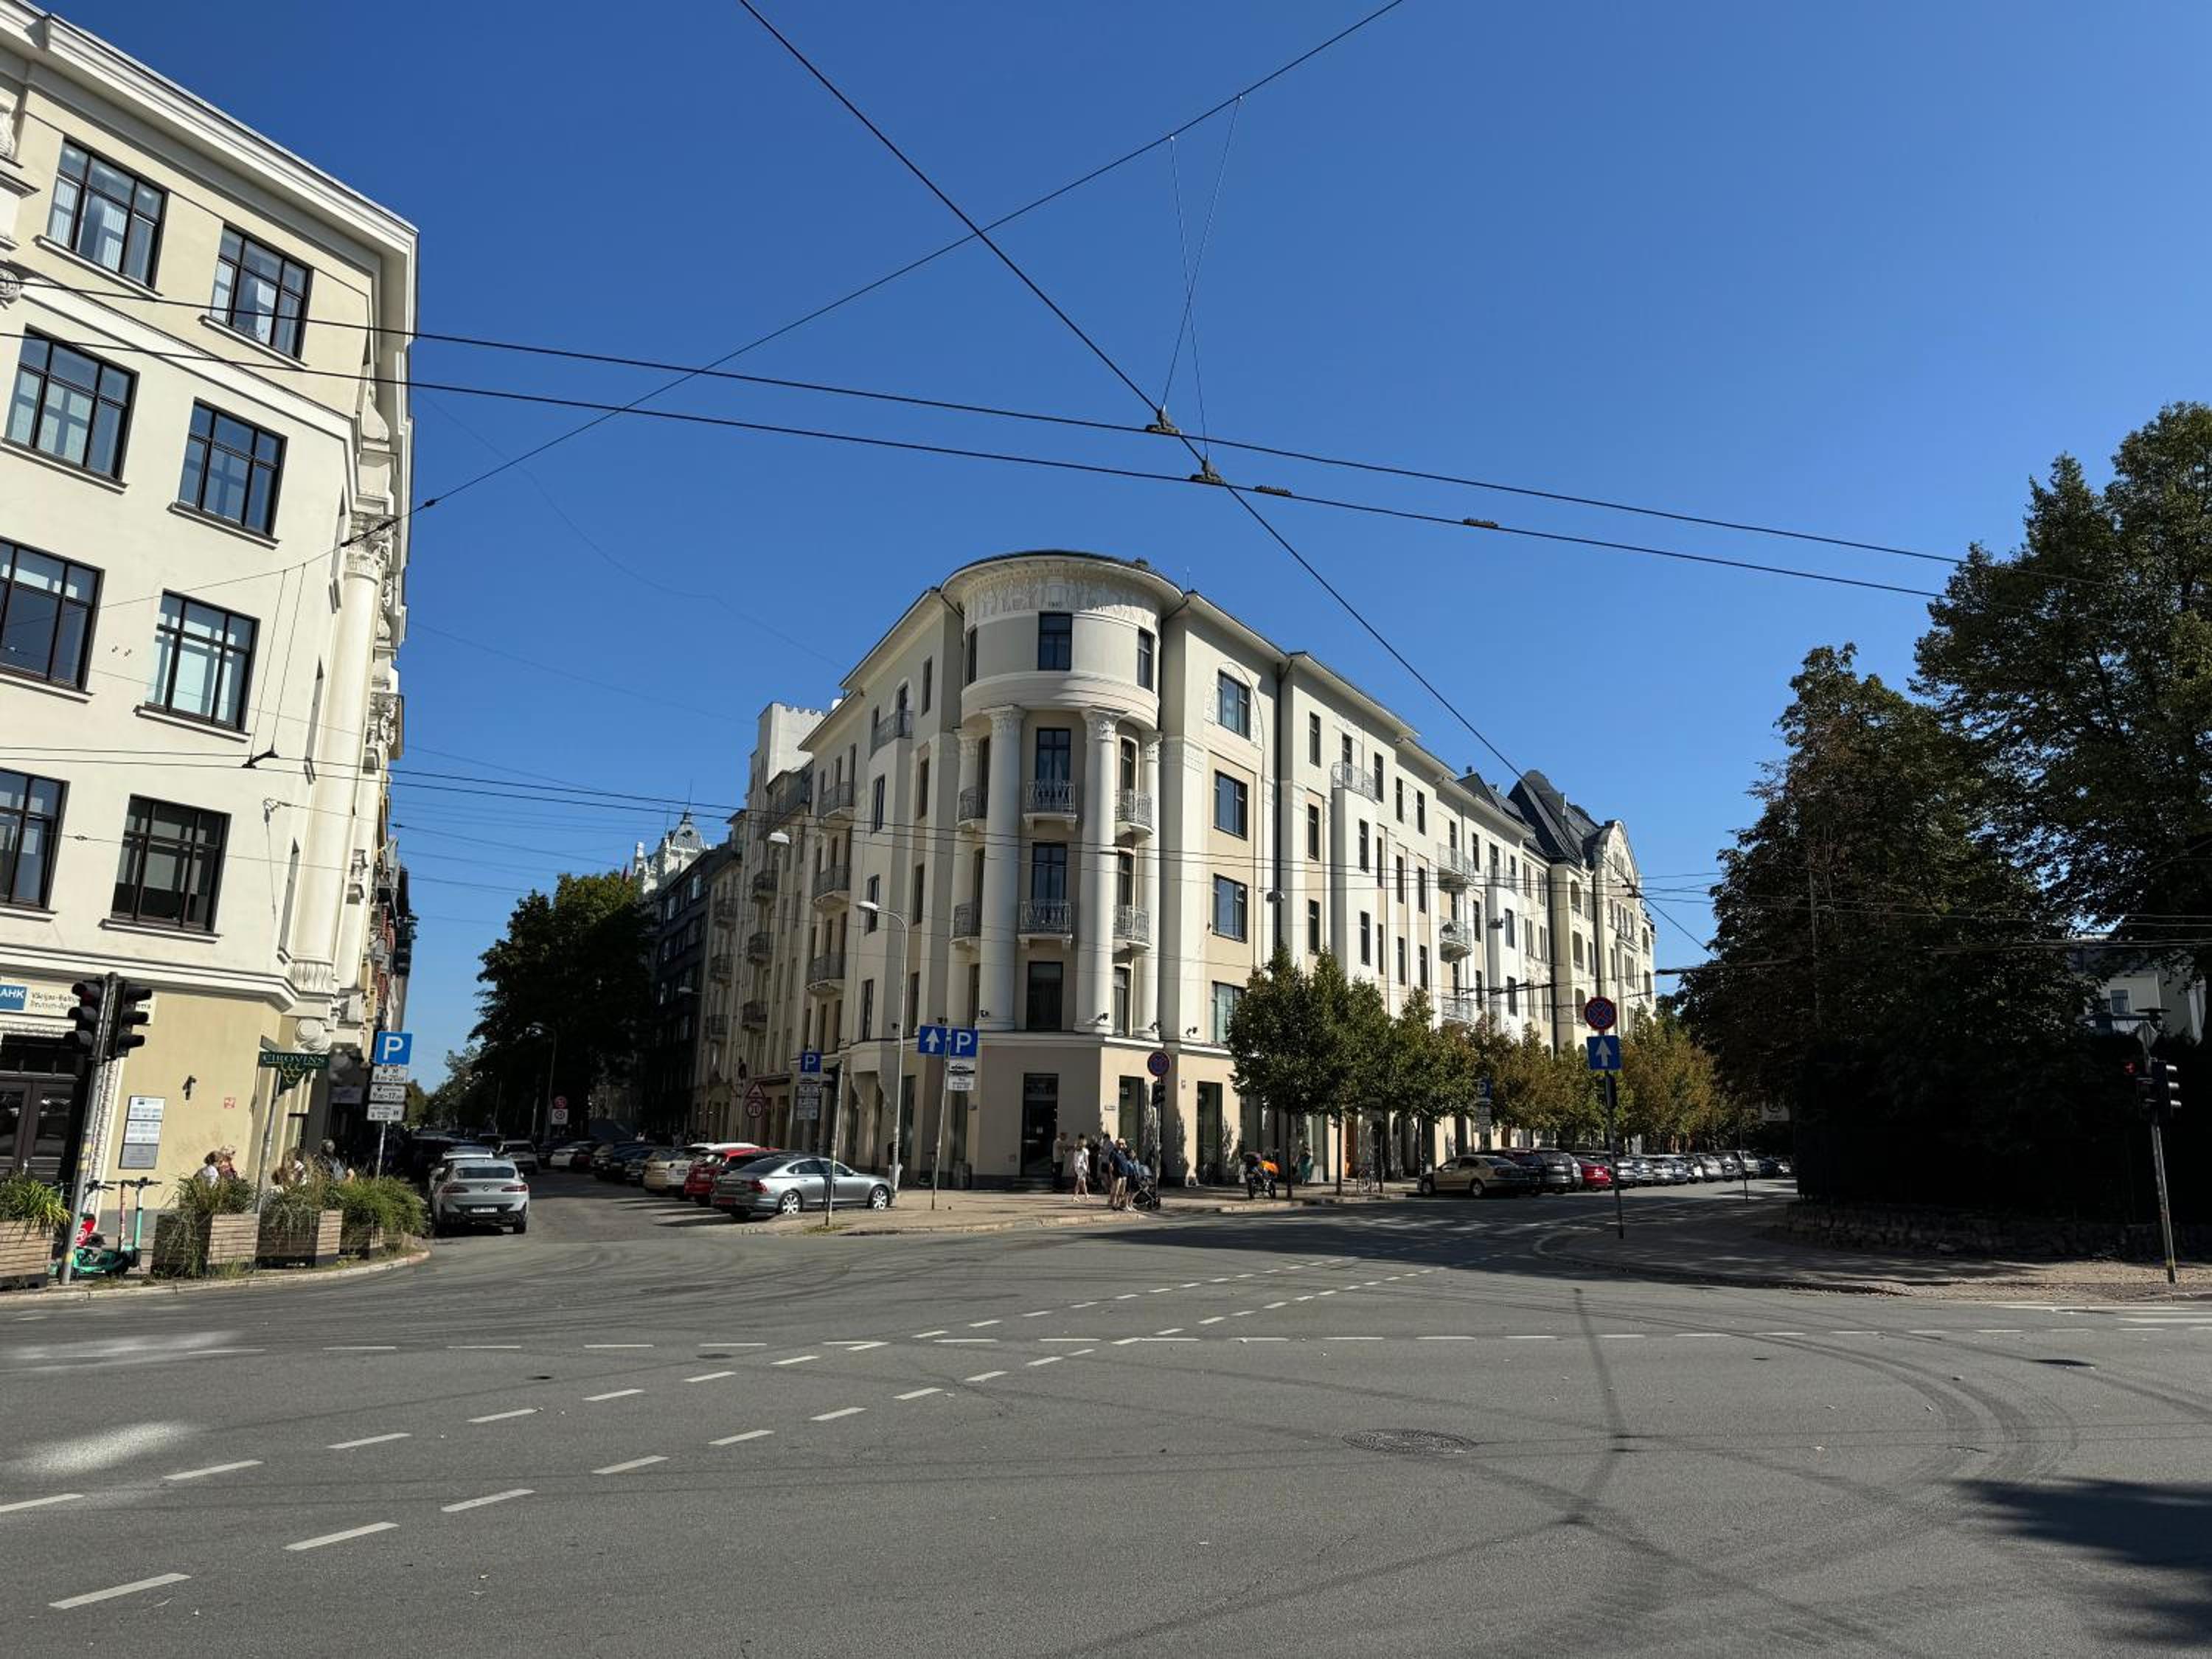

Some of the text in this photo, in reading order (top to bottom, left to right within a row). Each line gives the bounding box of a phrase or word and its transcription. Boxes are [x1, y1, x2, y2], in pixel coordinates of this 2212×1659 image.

[0, 988, 24, 998] AHK
[383, 1036, 403, 1061] P
[956, 1032, 973, 1054] P
[804, 1054, 816, 1071] P
